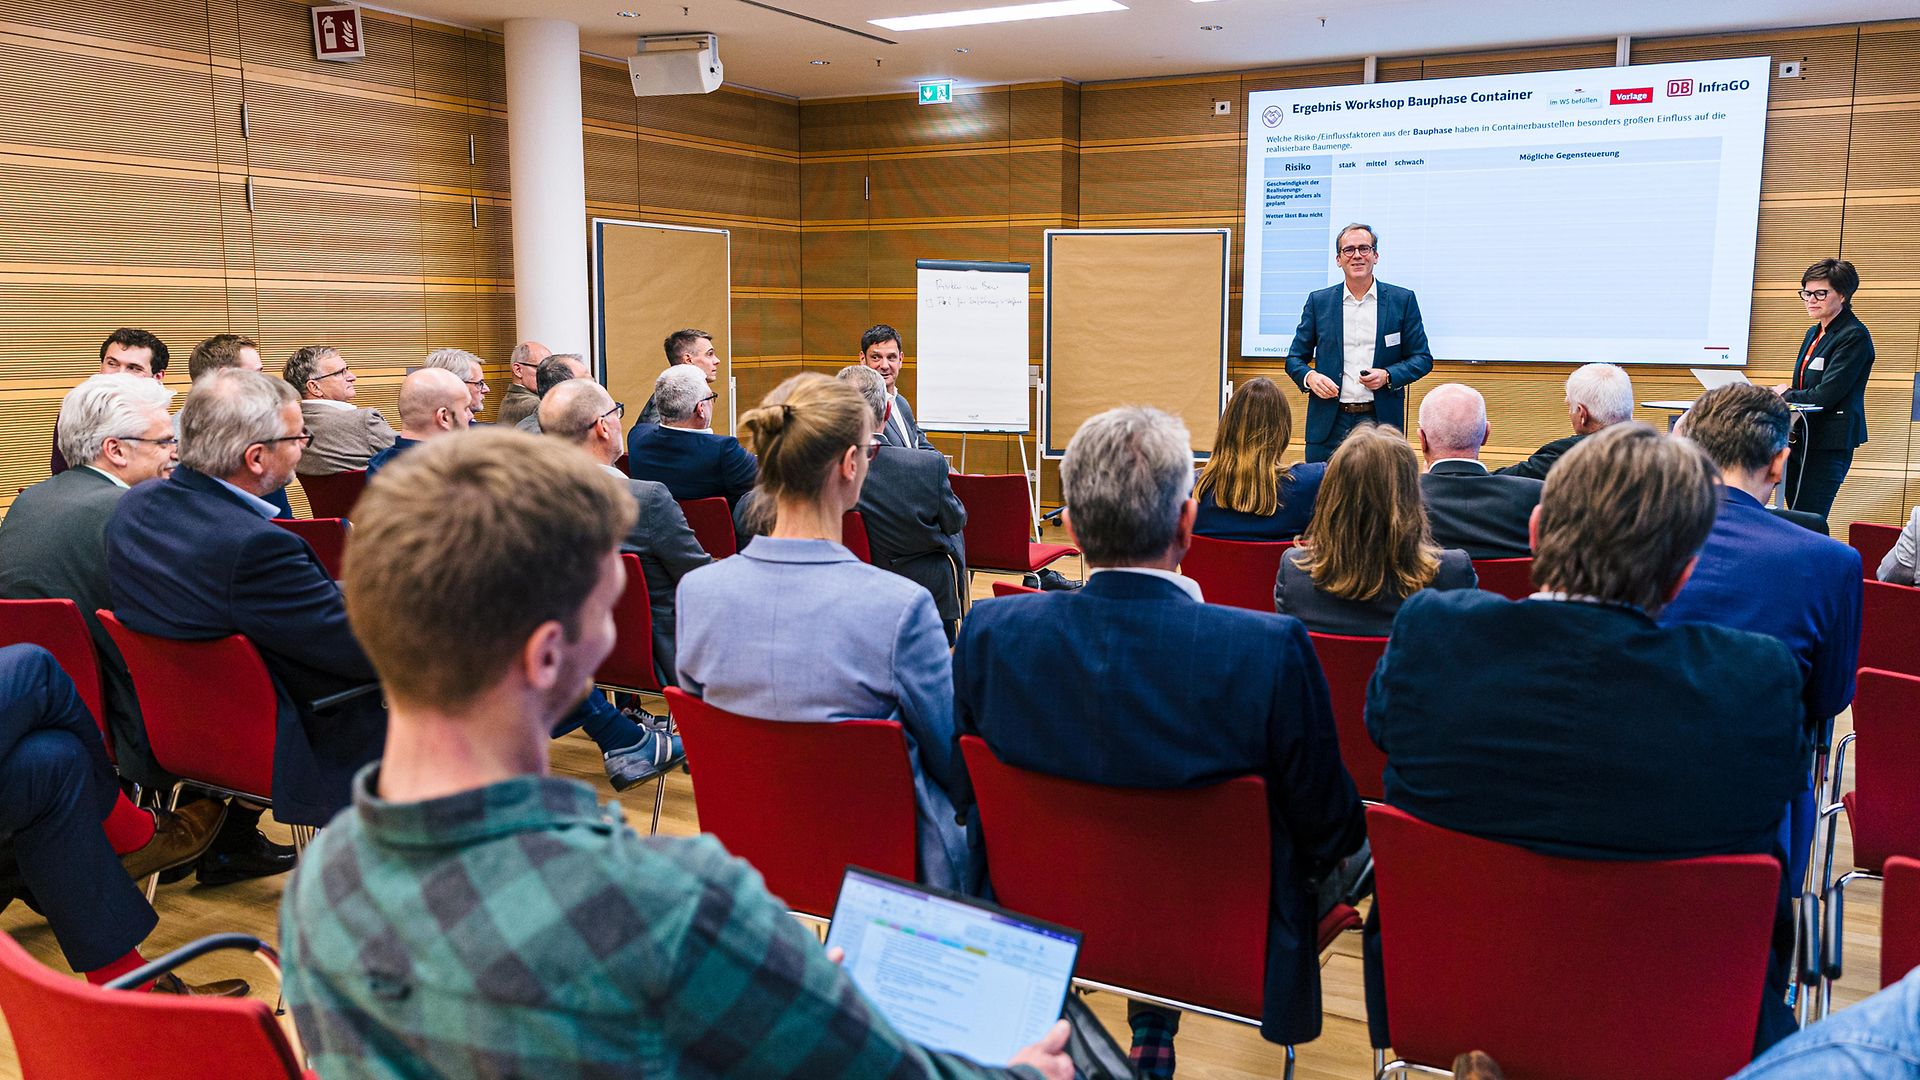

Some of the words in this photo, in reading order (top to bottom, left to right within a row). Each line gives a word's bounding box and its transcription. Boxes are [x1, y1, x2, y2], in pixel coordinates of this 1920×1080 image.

[1669, 80, 1691, 96] DB
[1699, 79, 1750, 93] InfraGO
[1292, 101, 1342, 115] Ergebnis
[1345, 97, 1405, 110] Workshop
[1408, 94, 1468, 107] Bauphase
[1470, 89, 1533, 103] Container
[1616, 92, 1648, 101] Vorlage
[1266, 134, 1292, 143] Welche
[1398, 128, 1411, 136] der
[1413, 126, 1453, 136] Bauphase
[1455, 124, 1479, 133] haben
[1482, 124, 1489, 132] in
[1491, 118, 1575, 131] Containerbaustellen
[1577, 117, 1621, 127] besonders
[1623, 115, 1654, 126] großen
[1657, 112, 1692, 123] Einfluss
[1694, 112, 1709, 121] auf
[1712, 111, 1726, 120] die
[1266, 144, 1310, 153] realisierbare
[1312, 142, 1352, 151] Baumenge.
[1394, 158, 1424, 166] schwach
[1519, 153, 1554, 162] Mögliche
[1556, 151, 1620, 160] Gegensteuerung
[1285, 163, 1311, 171] Risiko
